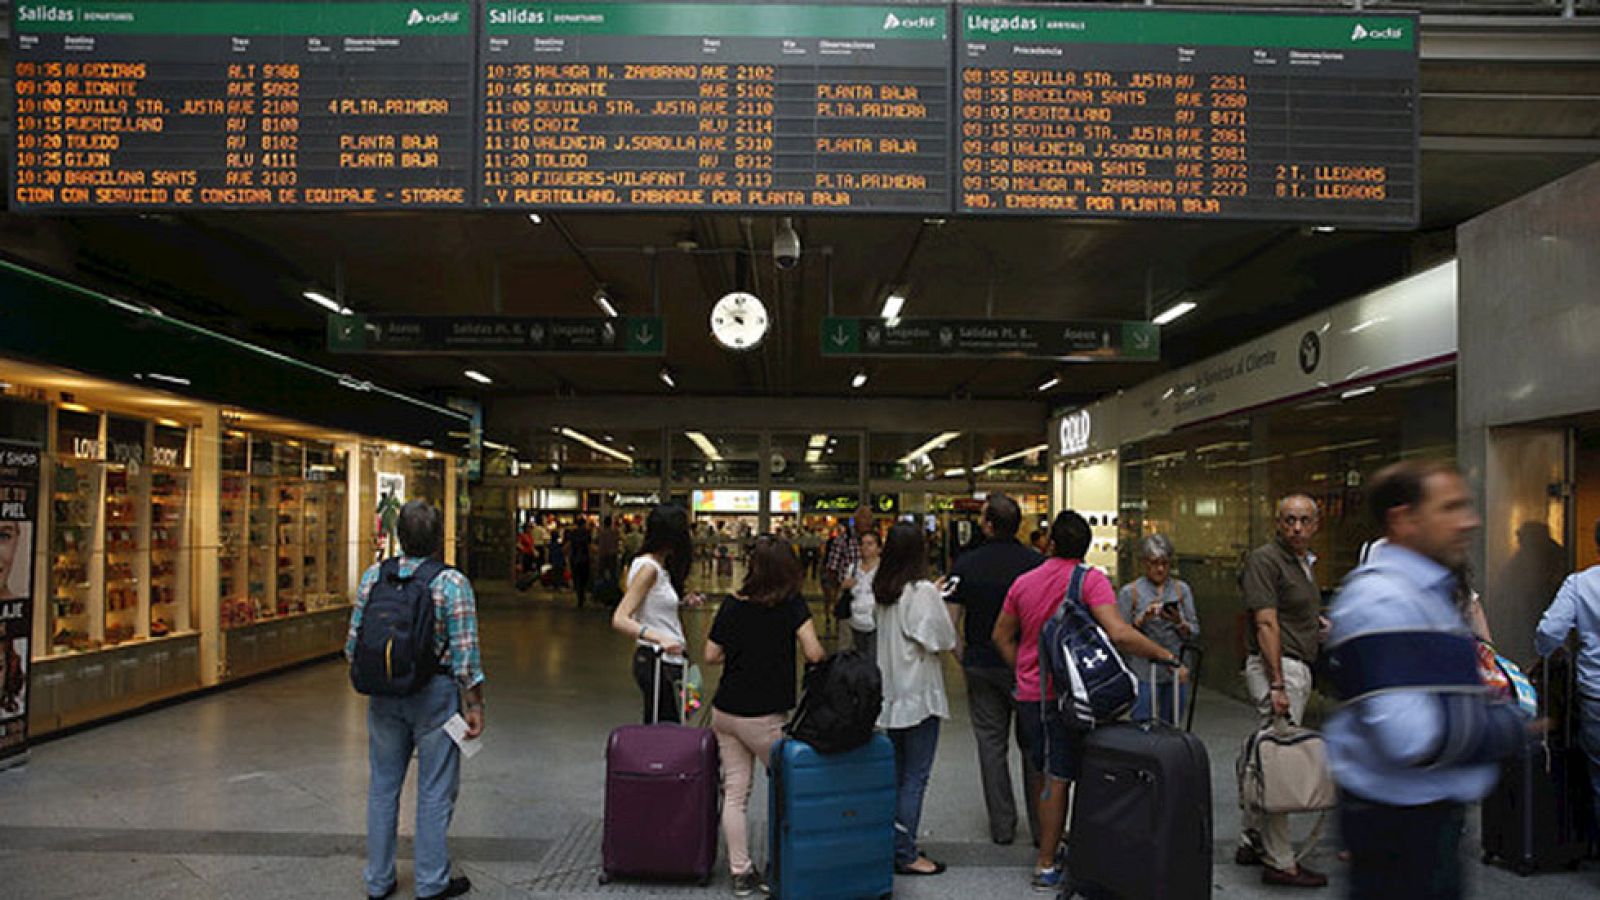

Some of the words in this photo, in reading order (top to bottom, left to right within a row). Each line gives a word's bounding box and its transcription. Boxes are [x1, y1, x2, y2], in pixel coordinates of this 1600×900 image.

[18, 6, 74, 22] Salidas
[489, 9, 544, 24] Salidas
[967, 15, 1037, 33] Llegadas
[488, 65, 531, 78] 10:35
[535, 65, 589, 78] MALAGA
[625, 65, 697, 78] ZAMBRANO
[701, 66, 727, 78] AVE
[1013, 71, 1076, 85] SEVILLA
[1130, 74, 1172, 87] JUSTA
[65, 81, 135, 95] ALICANTE
[228, 82, 254, 96] AVE
[488, 83, 530, 96] 10:45
[534, 82, 605, 96] ALICANTE
[700, 84, 727, 97] AVE
[818, 85, 872, 98] PLANTA
[880, 87, 917, 99] BAJA
[1012, 89, 1093, 102] BARCELONA
[1102, 91, 1145, 104] SANTS
[1176, 93, 1203, 106] AVE
[18, 99, 62, 112] 10:00
[65, 99, 127, 113] SEVILLA
[136, 100, 169, 113] STA.
[181, 100, 224, 113] JUSTA
[228, 101, 254, 114] AVE
[328, 101, 338, 113] 4
[487, 101, 530, 114] 11:00
[535, 100, 598, 114] SEVILLA
[653, 101, 696, 114] JUSTA
[701, 102, 727, 114] AVE
[1012, 106, 1111, 120] PUERTOLLANO
[18, 116, 61, 130] 10:15
[65, 117, 163, 131] PUERTOLLANO
[487, 118, 530, 132] 11:05
[534, 118, 579, 132] CADIZ
[700, 120, 728, 131] ALV
[736, 120, 772, 133] 2114
[1014, 124, 1075, 138] SEVILLA
[1131, 127, 1172, 140] JUSTA
[1176, 129, 1203, 142] AVE
[18, 134, 61, 148] 10:20
[67, 135, 119, 149] TOLEDO
[262, 136, 297, 150] 8102
[341, 135, 394, 148] PLANTA
[402, 135, 438, 149] BAJA
[486, 136, 529, 150] 11:10
[534, 136, 606, 149] VALENCIA
[700, 137, 725, 150] AVE
[817, 139, 872, 151] PLANTA
[880, 140, 916, 152] BAJA
[1013, 142, 1084, 155] VALENCIA
[1177, 146, 1203, 159] AVE
[18, 152, 61, 166] 10:25
[65, 152, 110, 167] GIJON
[227, 154, 253, 167] ALV
[262, 154, 296, 167] 4111
[340, 153, 394, 167] PLANTA
[401, 153, 438, 167] BAJA
[486, 154, 529, 168] 11:20
[535, 154, 588, 167] TOLEDO
[65, 170, 144, 184] BARCELONA
[152, 171, 196, 185] SANTS
[227, 171, 252, 185] AVE
[1013, 160, 1093, 174] BARCELONA
[1102, 162, 1146, 175] SANTS
[1176, 164, 1203, 177] AVE
[1277, 166, 1285, 179] 2
[1316, 168, 1385, 180] LLEGADAS
[532, 172, 685, 185] FIGUERES-VILAFANT
[699, 173, 725, 185] AVE
[17, 188, 54, 202] CION
[61, 188, 88, 202] CON
[96, 188, 167, 202] SERVICIO
[175, 188, 192, 203] DE
[201, 189, 271, 202] CONSIGNA
[279, 189, 296, 202] DE
[305, 189, 376, 202] EQUIPAJE
[401, 188, 464, 202] STORAGE
[1012, 178, 1067, 191] MALAGA
[1102, 179, 1172, 193] ZAMBRANO
[1176, 182, 1203, 195] AVE
[1316, 185, 1385, 199] LLEGADAS
[497, 189, 508, 203] Y
[631, 190, 703, 203] EMBARQUE
[712, 190, 741, 204] POR
[748, 191, 804, 204] PLANTA
[812, 192, 850, 205] BAJA
[1006, 195, 1077, 208] EMBARQUE
[1086, 196, 1114, 210] POR
[1121, 198, 1176, 211] PLANTA
[1182, 199, 1220, 212] BAJA
